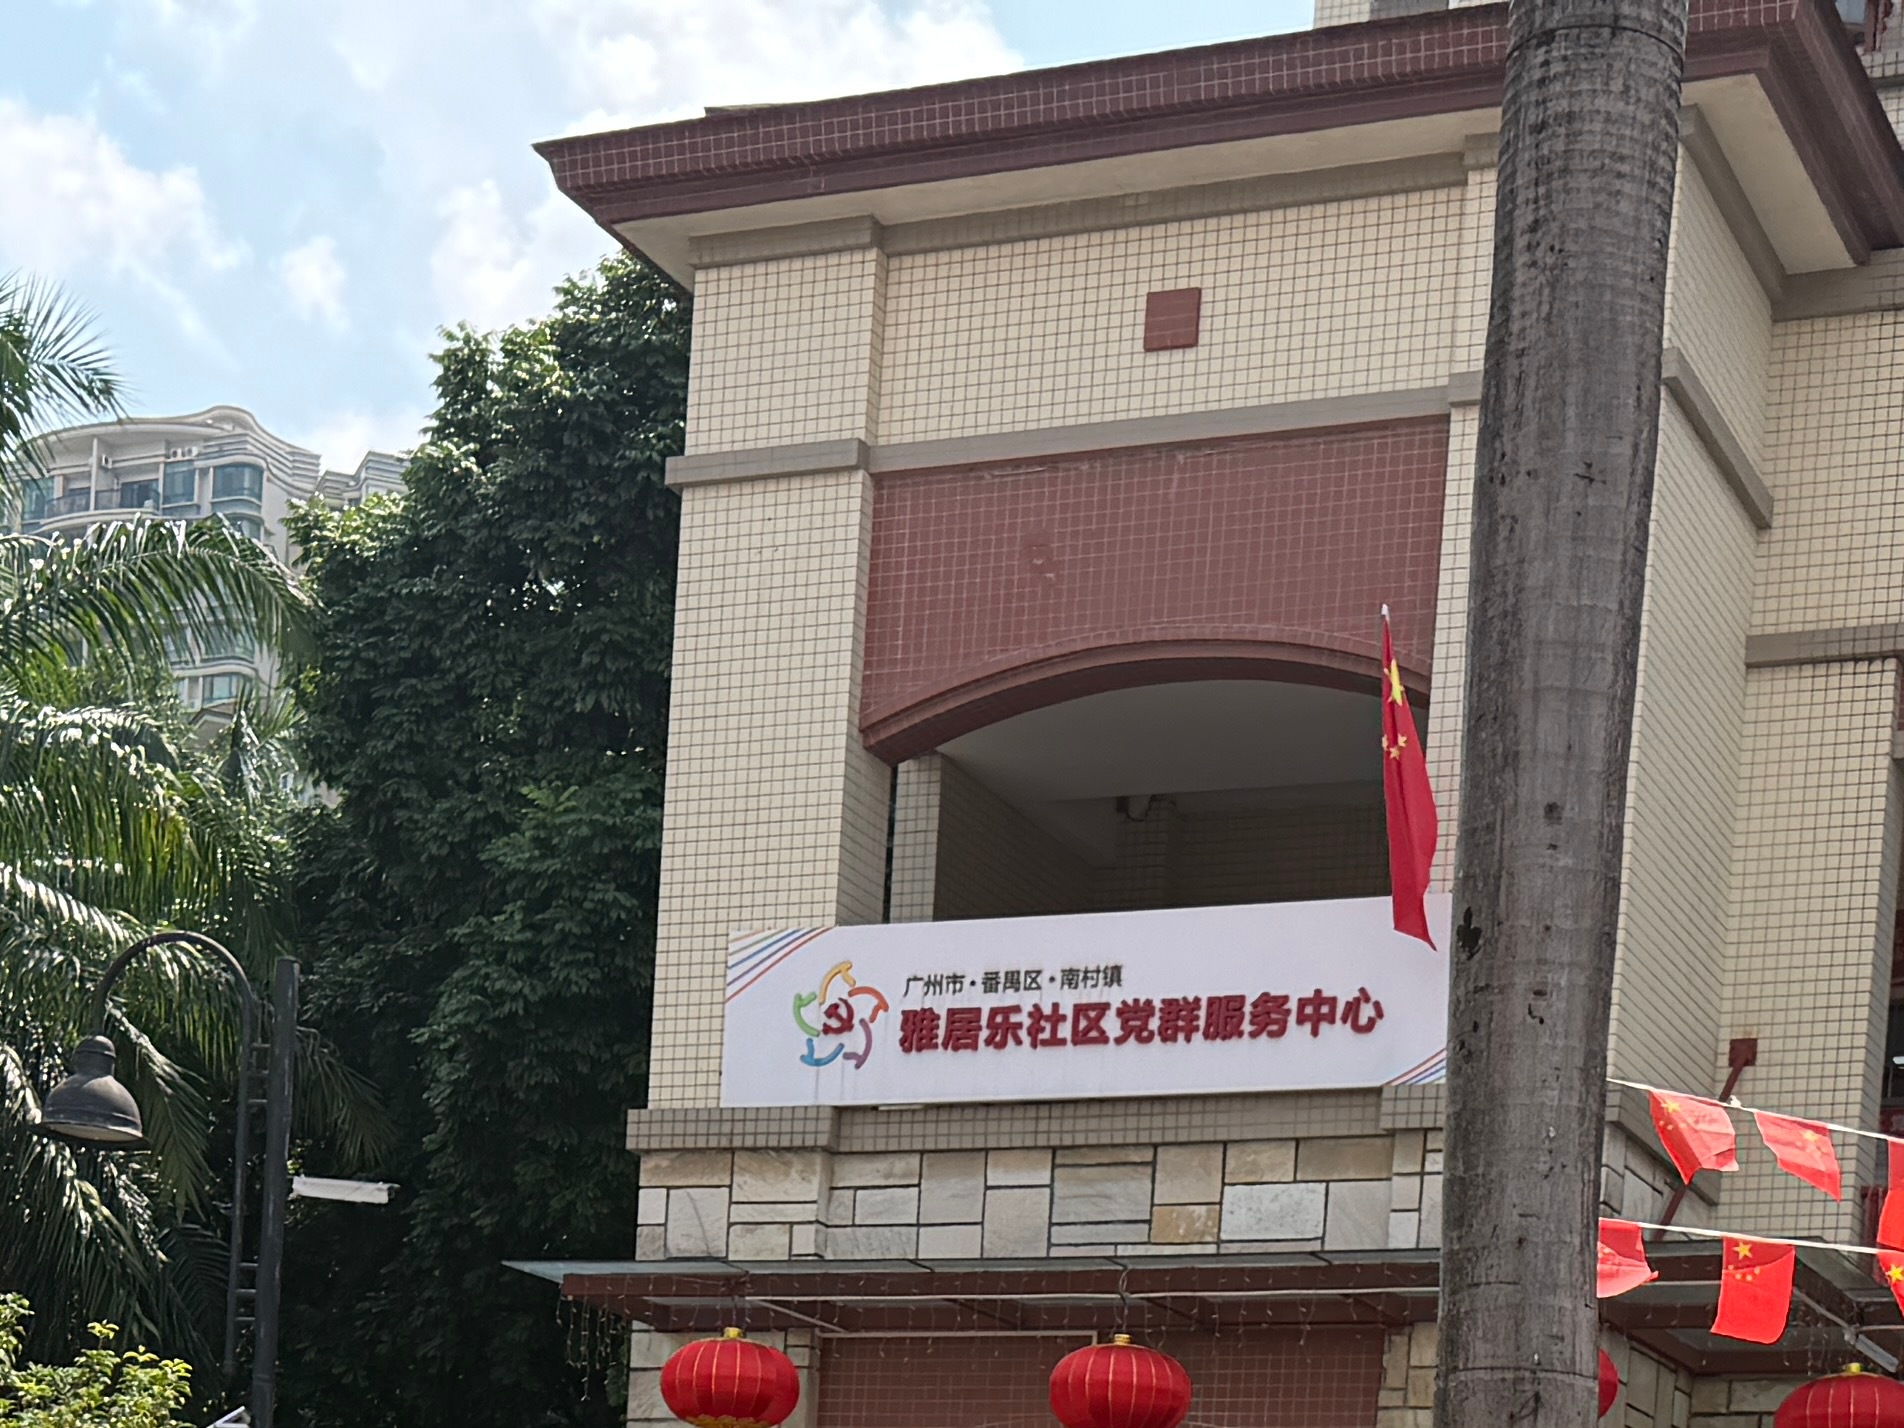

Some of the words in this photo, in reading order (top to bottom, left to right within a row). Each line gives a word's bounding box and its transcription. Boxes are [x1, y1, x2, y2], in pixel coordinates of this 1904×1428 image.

[897, 986, 1385, 1055] 雅居乐社区党群服务中心
